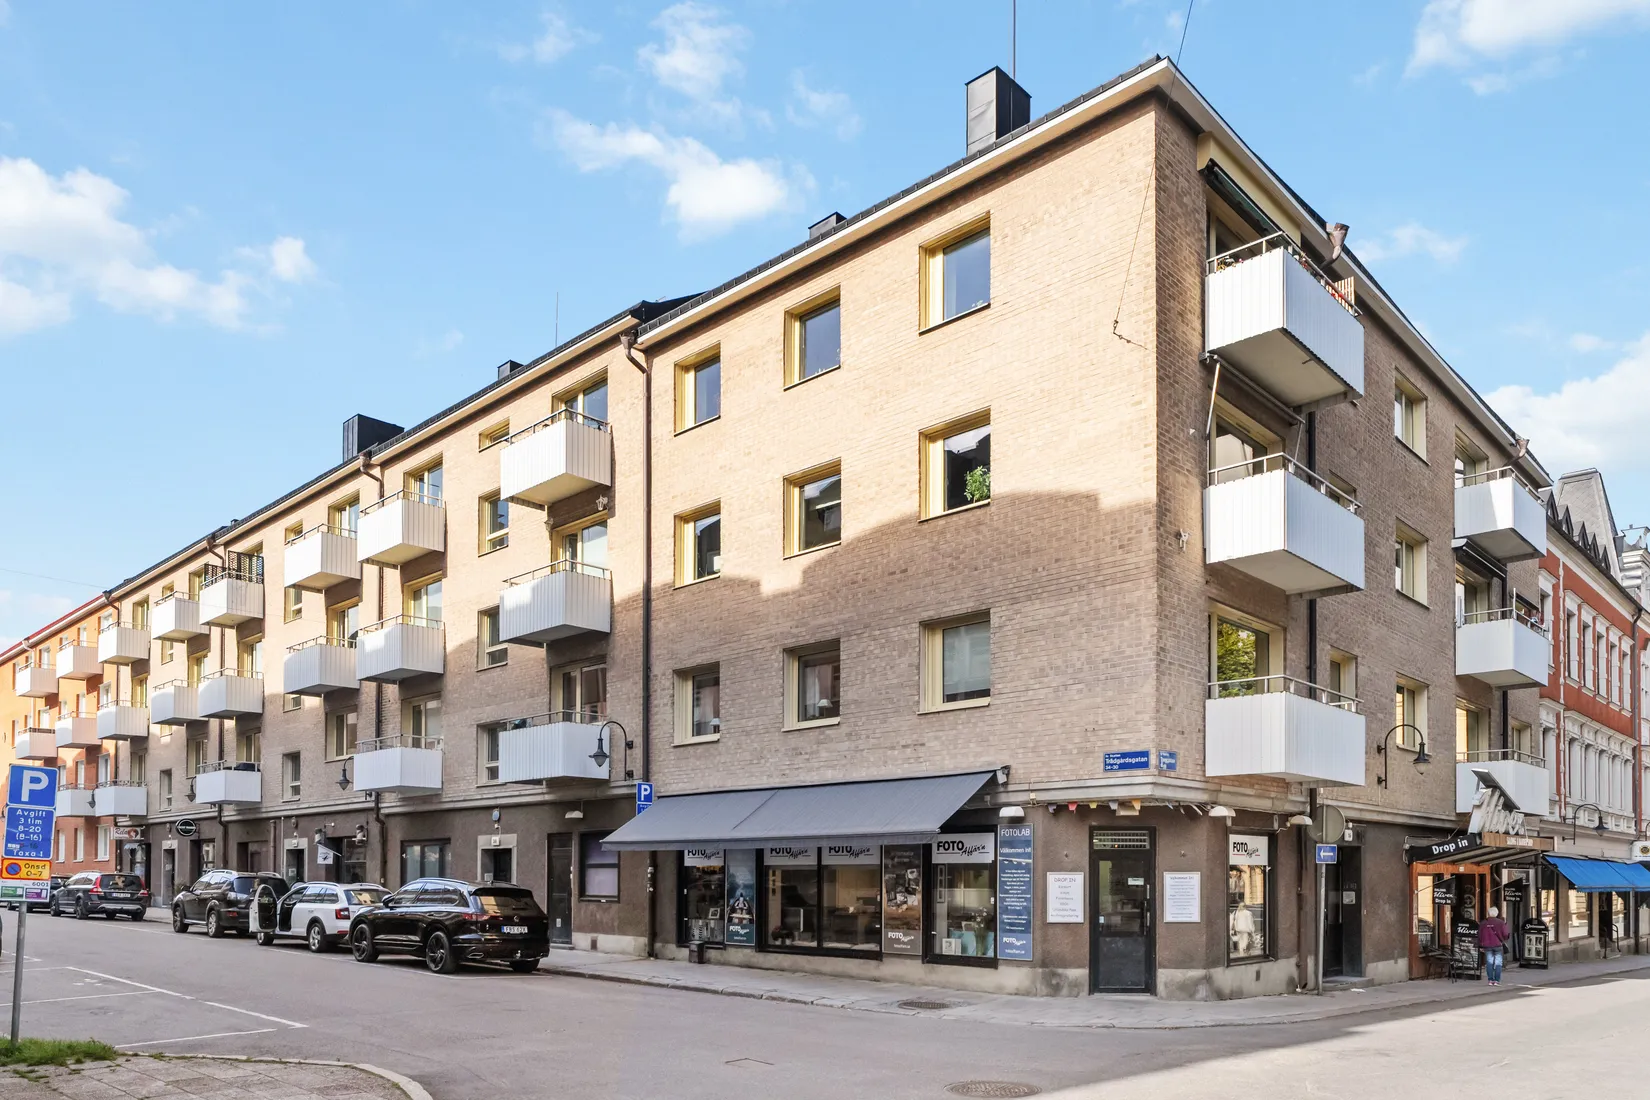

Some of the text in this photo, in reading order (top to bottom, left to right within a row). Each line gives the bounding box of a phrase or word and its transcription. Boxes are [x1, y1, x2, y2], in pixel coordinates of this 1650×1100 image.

[1105, 756, 1148, 765] Trädgårdsgatan
[21, 769, 49, 802] P
[641, 784, 651, 801] P
[16, 808, 46, 818] Avgift
[28, 817, 42, 825] tim
[16, 832, 42, 841] (8-16)
[1001, 828, 1030, 837] FOTOLAB
[936, 840, 965, 852] FOTO
[1232, 841, 1249, 853] FOTO
[1432, 839, 1469, 855] Drop in
